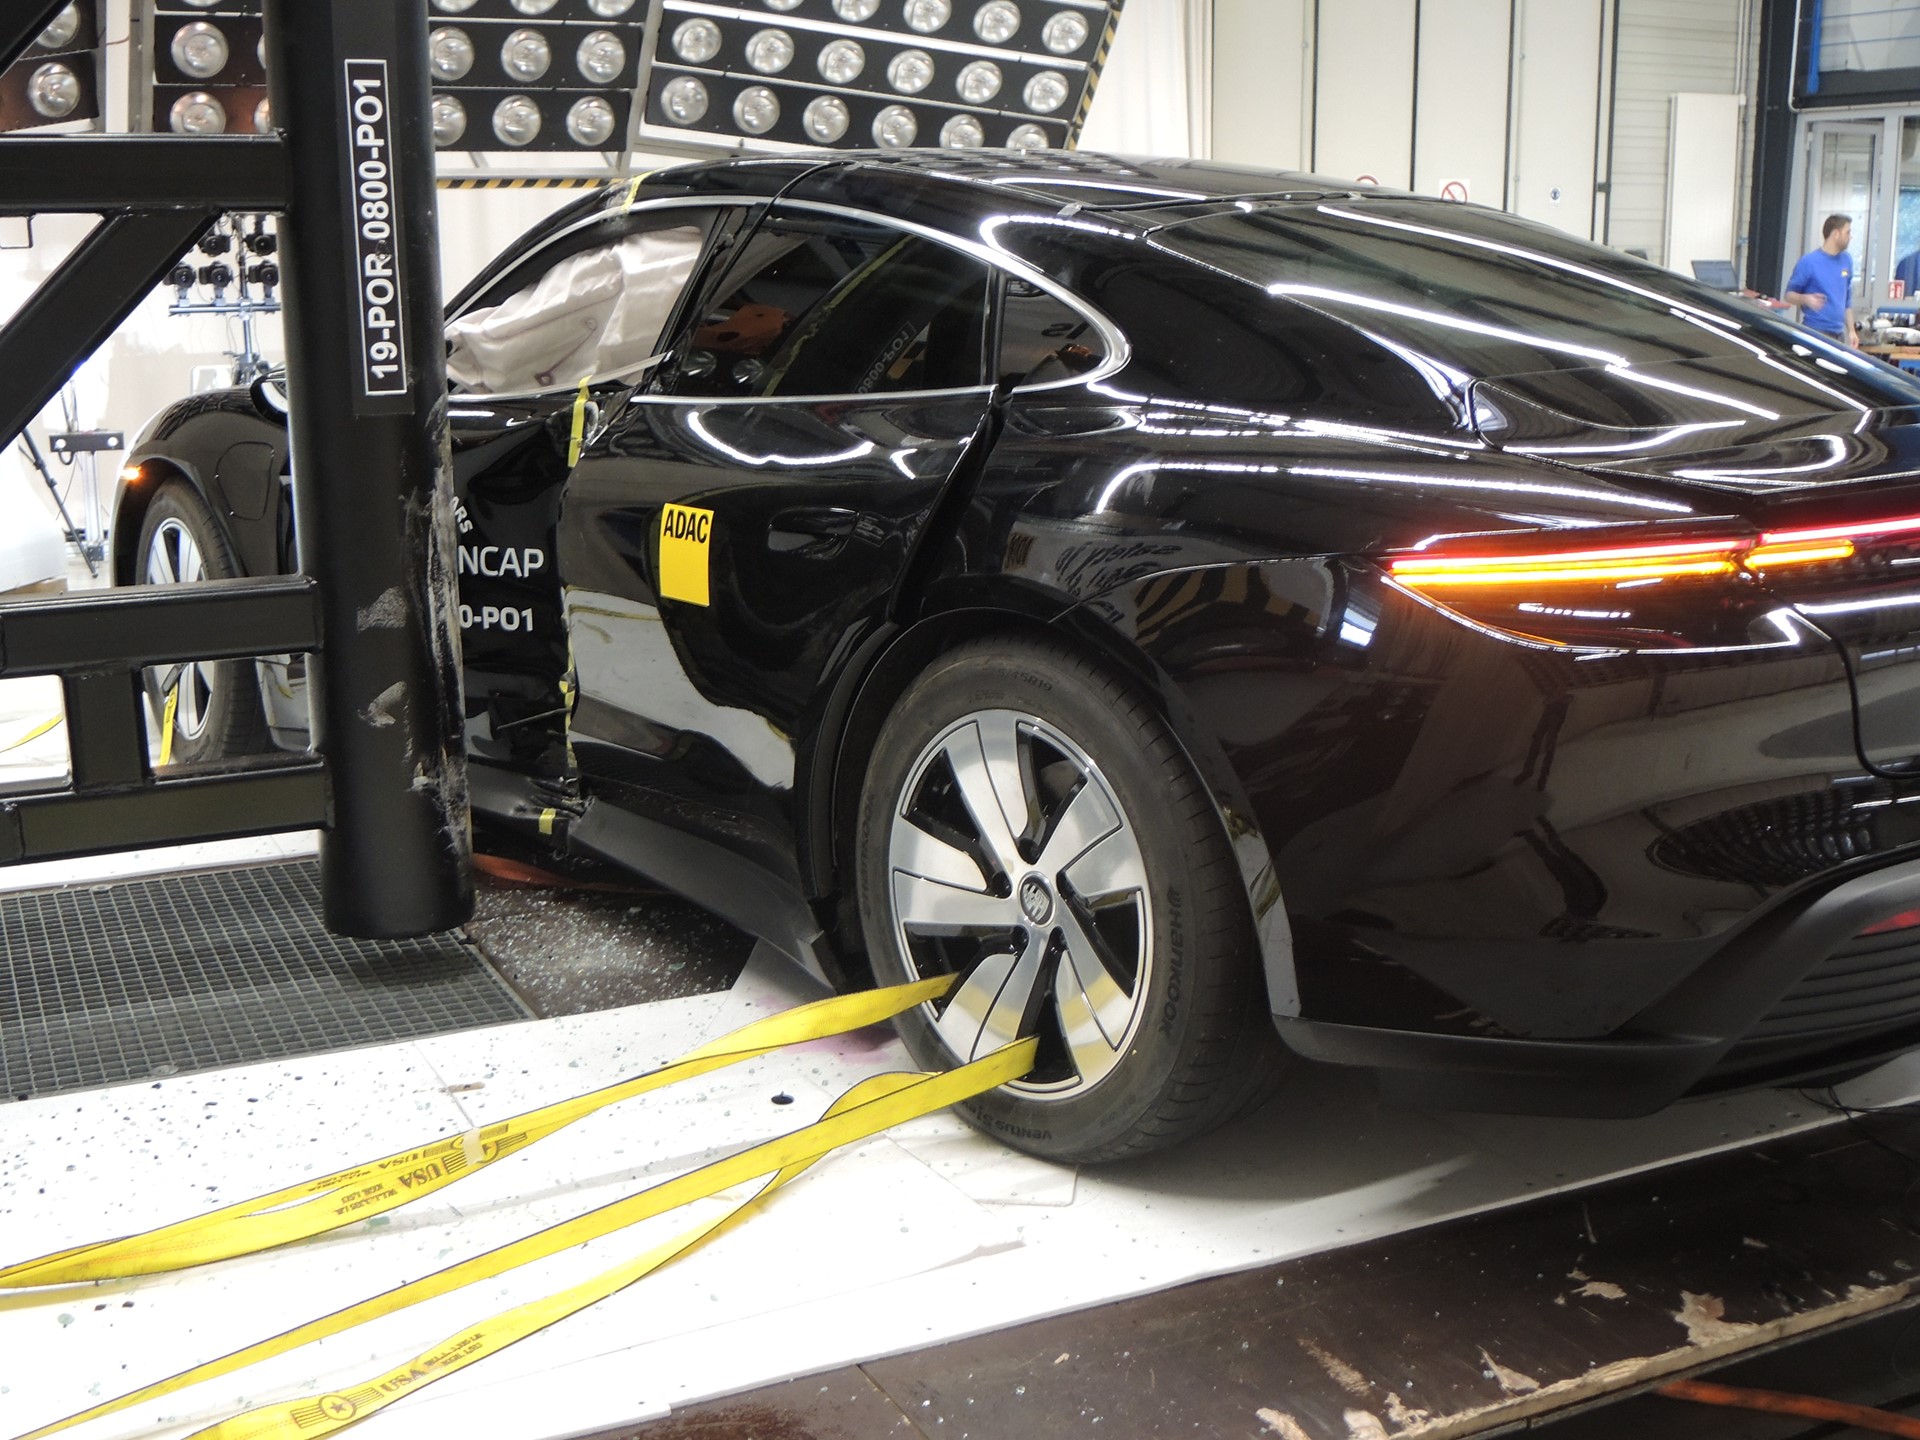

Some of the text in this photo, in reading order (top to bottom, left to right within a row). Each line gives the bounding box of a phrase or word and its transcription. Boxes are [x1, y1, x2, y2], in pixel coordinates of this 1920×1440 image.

[353, 78, 399, 380] 19-POR 0800-PO1
[663, 508, 709, 544] ADAC
[458, 544, 544, 578] NCAP
[397, 1162, 442, 1189] USA
[379, 1369, 429, 1392] USA
